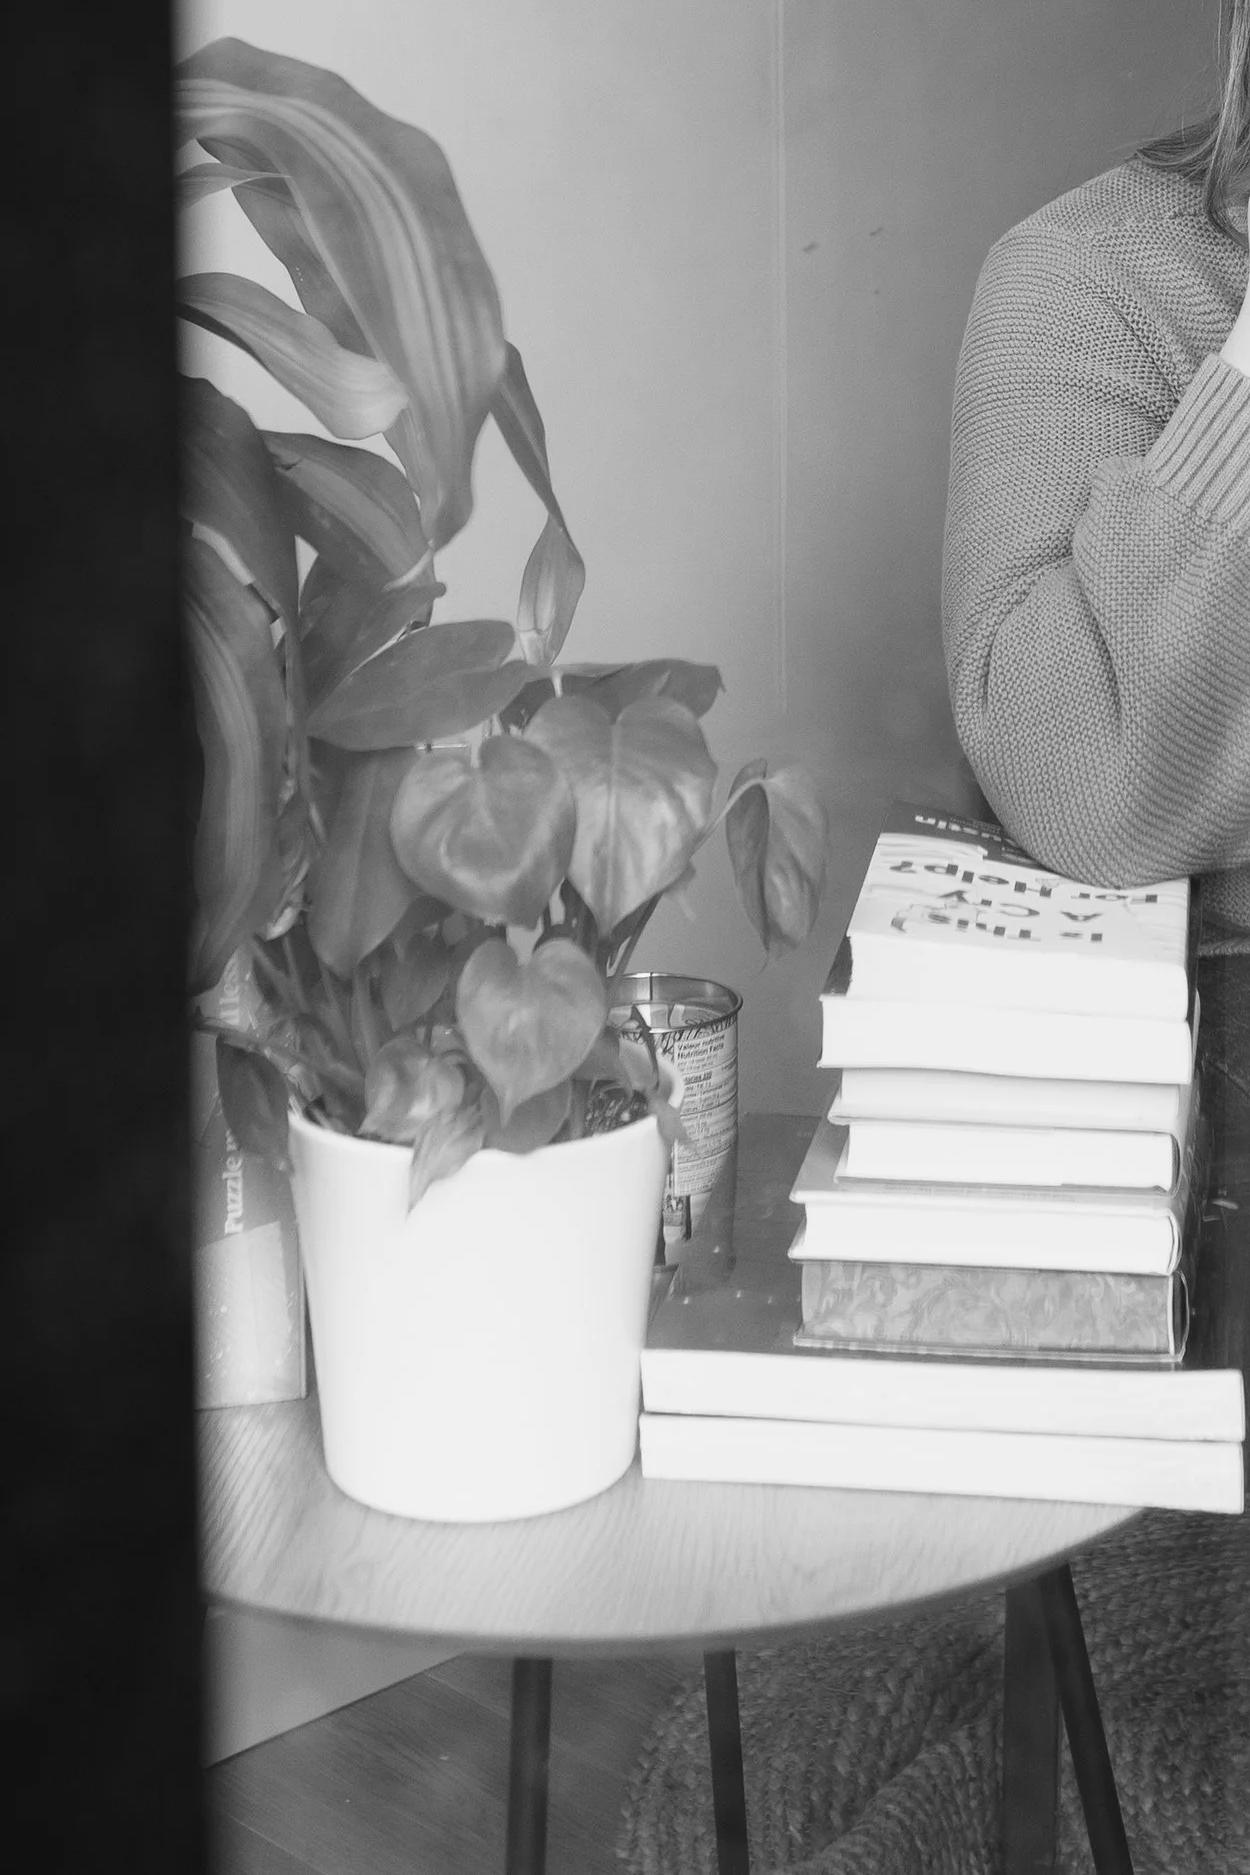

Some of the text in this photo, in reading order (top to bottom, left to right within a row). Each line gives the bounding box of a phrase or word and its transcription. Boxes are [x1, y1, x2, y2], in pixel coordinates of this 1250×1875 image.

[914, 814, 1017, 845] ustin
[889, 860, 1158, 904] For Help?
[938, 889, 1102, 922] A Cry
[926, 911, 1103, 943] Is This
[677, 1048, 709, 1060] Nutrition
[222, 1155, 244, 1235] Puzzle
